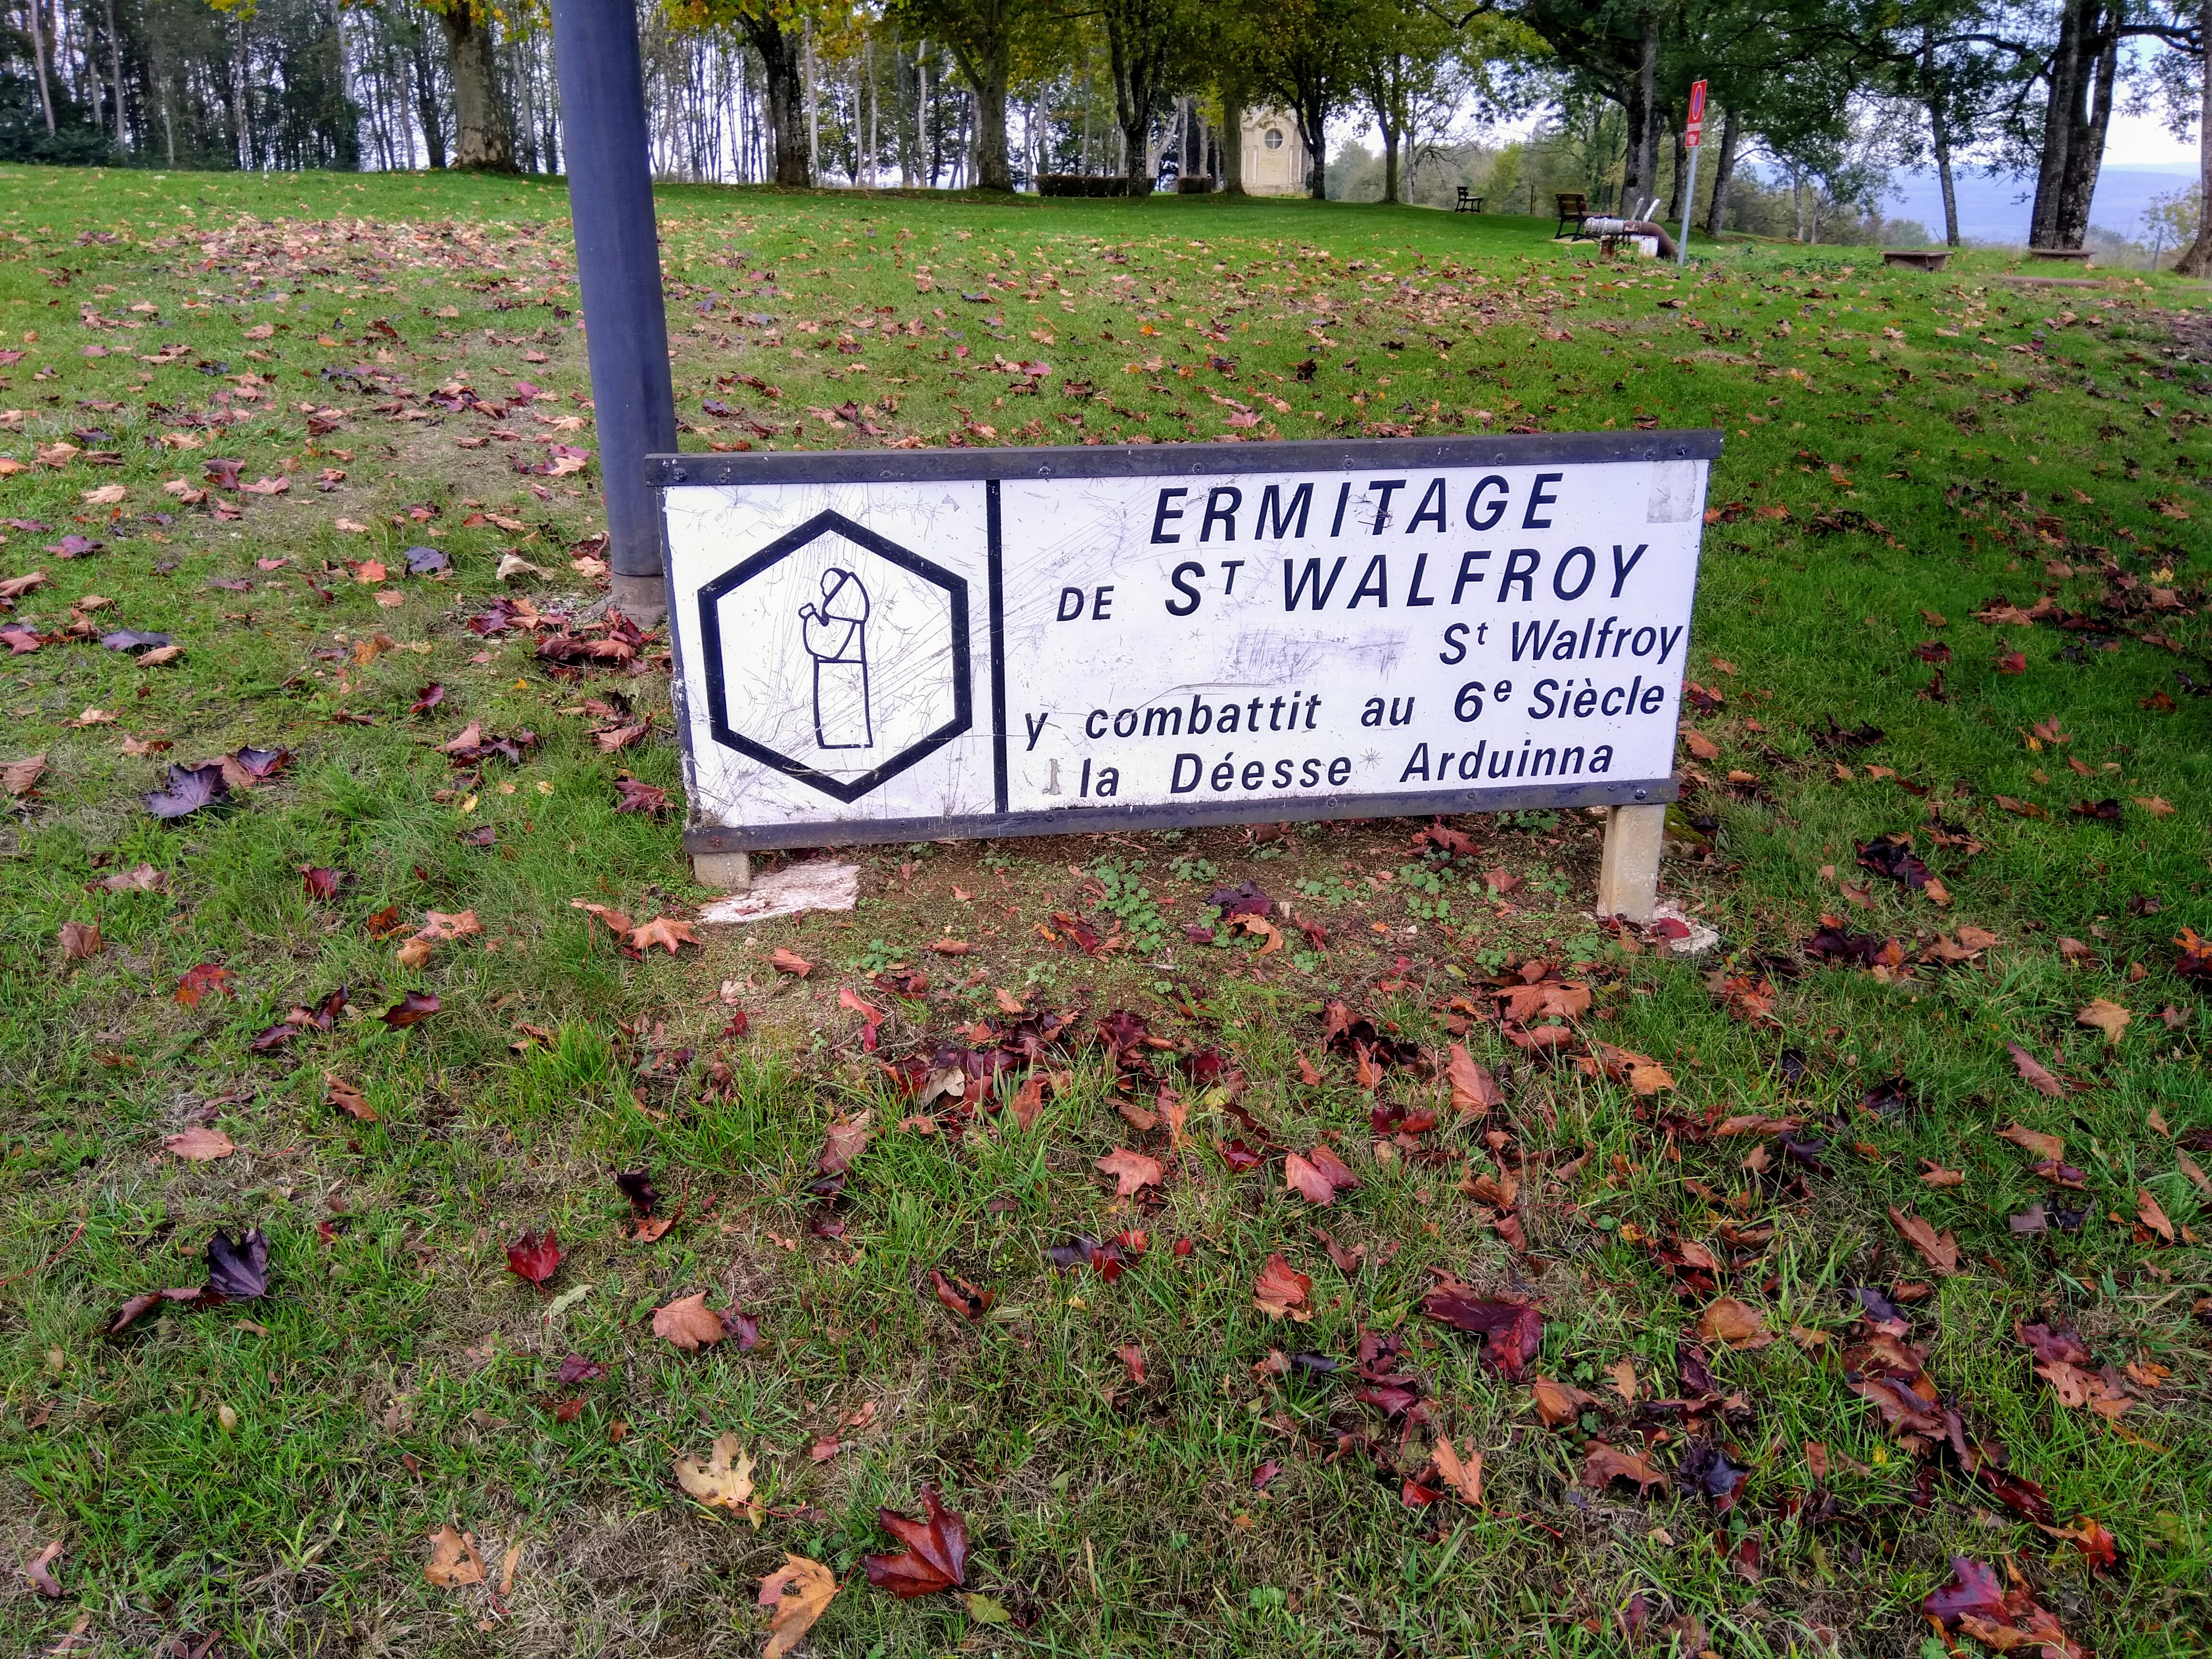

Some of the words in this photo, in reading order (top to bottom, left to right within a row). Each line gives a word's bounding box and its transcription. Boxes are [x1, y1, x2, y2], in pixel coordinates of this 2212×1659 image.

[1150, 473, 1563, 543] ERMITAGE
[1057, 586, 1114, 621] DE
[1166, 561, 1245, 616] ST
[1285, 545, 1648, 611] WALFROY
[1440, 623, 1488, 664] St
[1513, 617, 1683, 664] Walfroy
[1025, 713, 1048, 751] y
[1086, 692, 1321, 739] combattit
[1361, 697, 1415, 726] au
[1455, 680, 1512, 722] 6e
[1528, 675, 1664, 719] Siècle
[1080, 758, 1118, 797] la
[1170, 752, 1352, 793] Déesse
[1399, 740, 1614, 782] Arduinna
